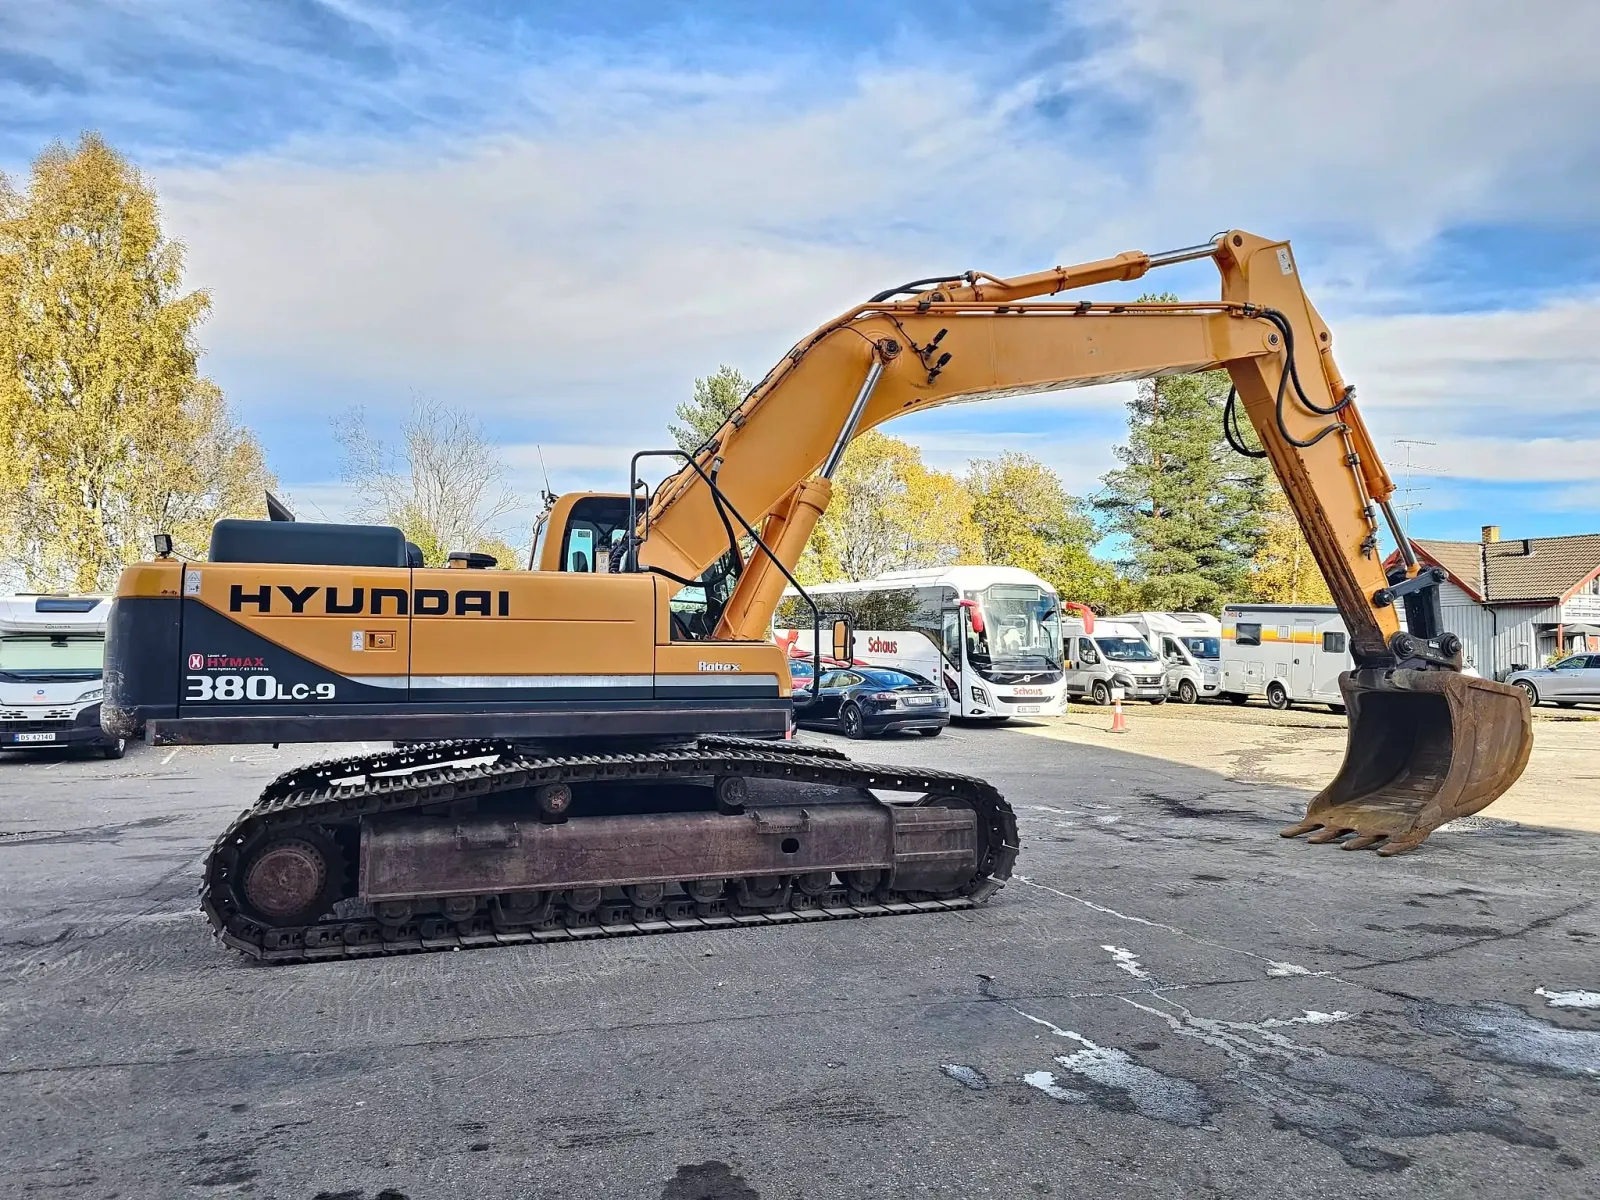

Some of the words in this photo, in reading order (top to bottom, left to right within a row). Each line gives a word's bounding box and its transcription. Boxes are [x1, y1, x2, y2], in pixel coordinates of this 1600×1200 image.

[230, 584, 509, 617] HYUNDAI
[868, 636, 898, 654] Schaus
[207, 657, 265, 667] HYMAX
[1013, 687, 1043, 696] Schaus
[32, 733, 53, 741] 42140
